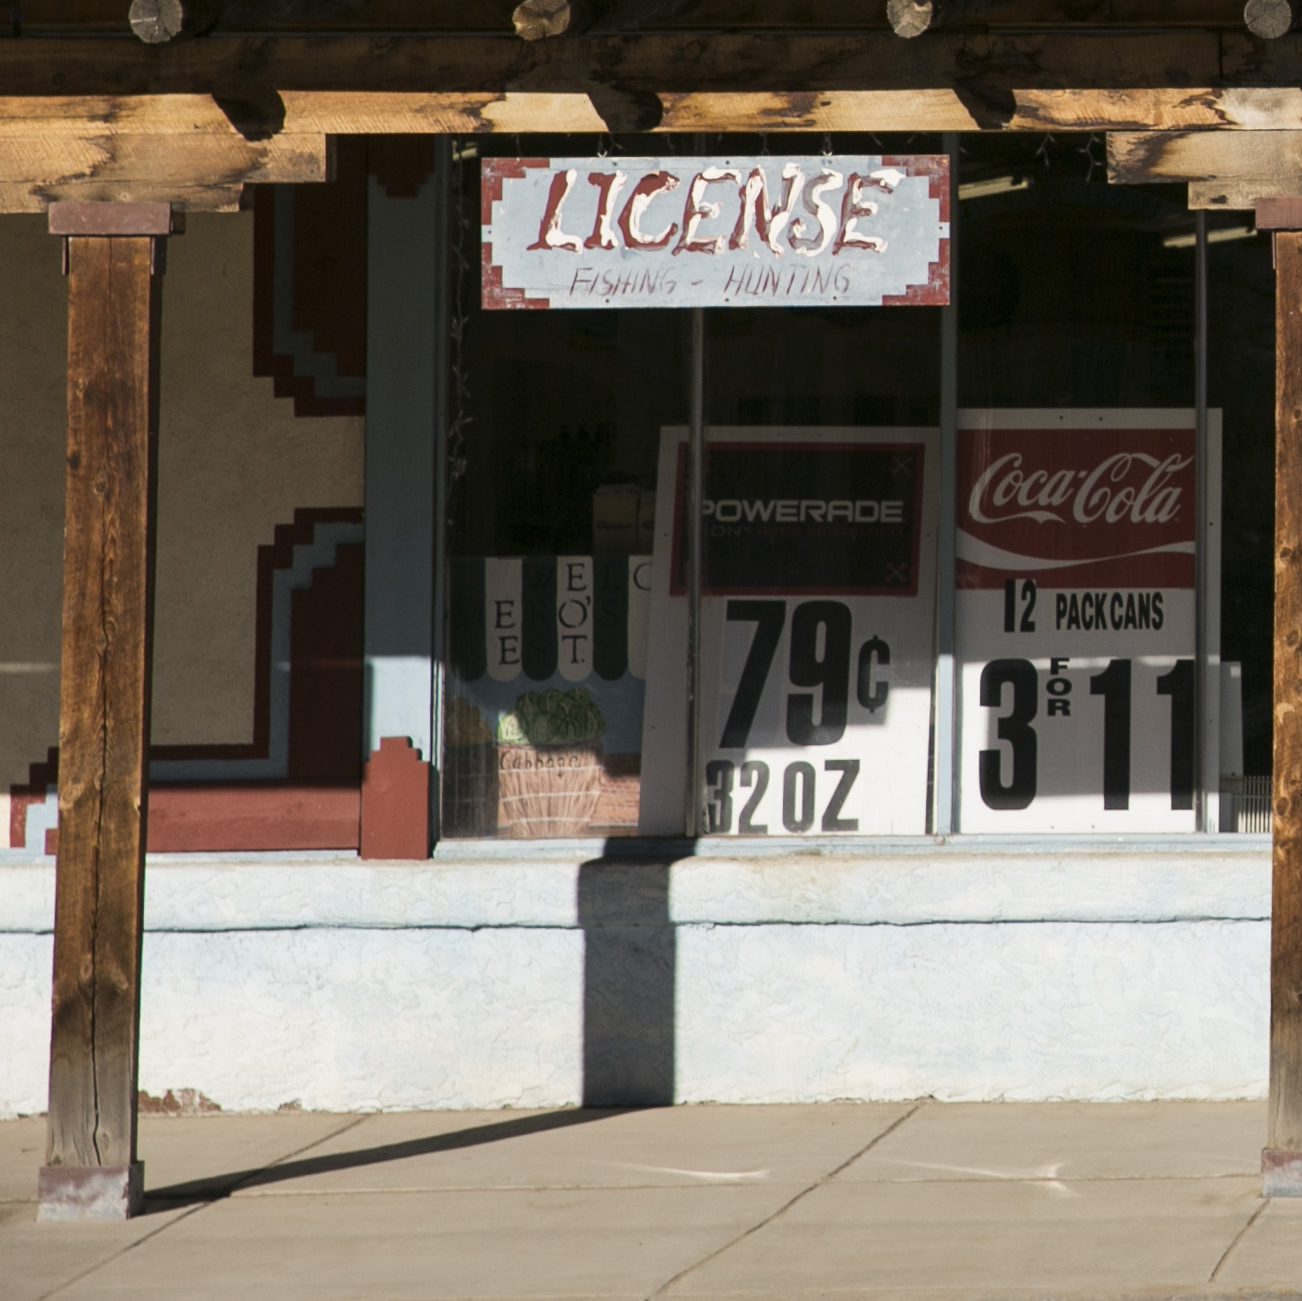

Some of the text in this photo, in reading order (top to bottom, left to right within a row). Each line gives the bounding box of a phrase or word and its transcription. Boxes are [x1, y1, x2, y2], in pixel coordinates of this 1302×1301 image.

[527, 162, 906, 258] LICENSE
[569, 265, 677, 296] FISHING
[723, 262, 851, 296] HUNTING
[969, 452, 1194, 524] Coca-Cola
[1004, 579, 1164, 632] 12 PACK CANS
[979, 658, 1038, 811] 3
